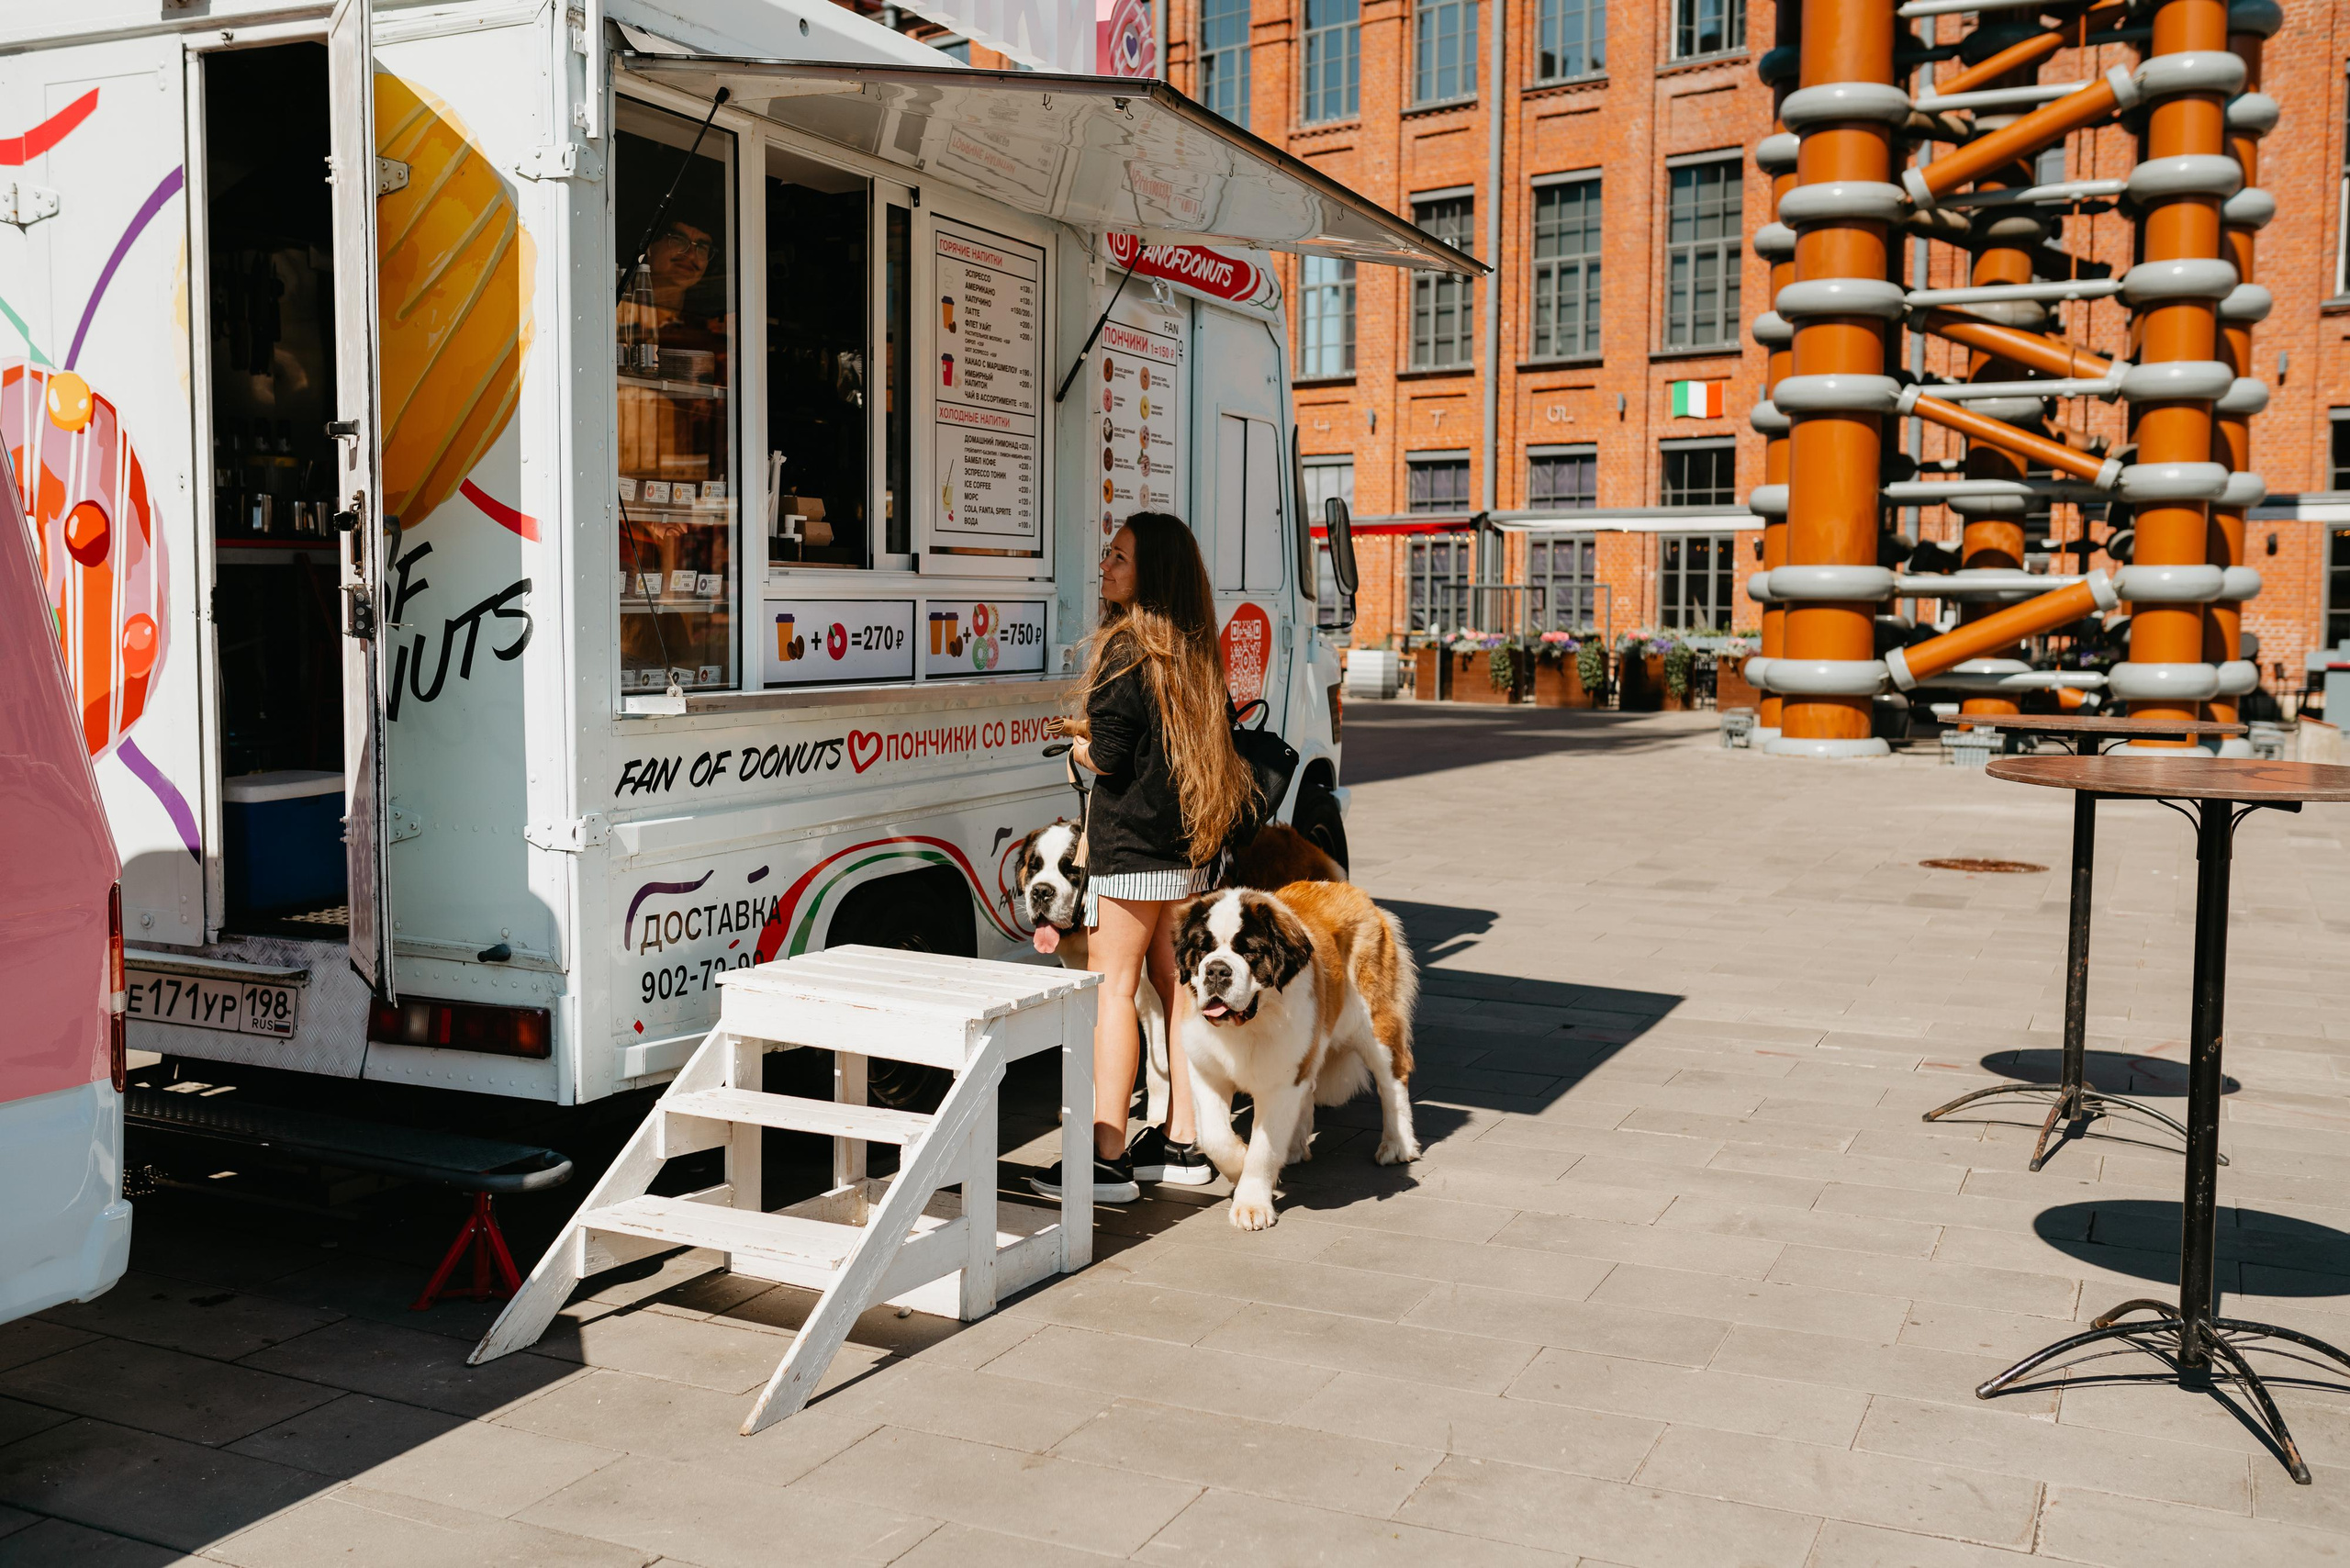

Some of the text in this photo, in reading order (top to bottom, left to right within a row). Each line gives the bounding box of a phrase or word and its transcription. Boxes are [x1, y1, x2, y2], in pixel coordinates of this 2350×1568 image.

[939, 239, 1002, 267] ГОРЯЧИЕ НАПИТКИ
[965, 268, 991, 283] ЭСПРЕССО
[965, 282, 996, 297] АМЕРИКАНО
[965, 294, 991, 308] КАПУЧИНО
[965, 306, 980, 318] ЛАТТЕ
[965, 319, 979, 329] ФЛЕТ
[979, 321, 991, 332] УАЙТ
[1164, 321, 1179, 335] FAN
[1104, 326, 1148, 353] ПОНЧИКИ
[965, 356, 981, 367] КАКАО
[965, 368, 993, 381] ИМБИРНЫЙ
[965, 378, 988, 389] НАПИТОК
[965, 389, 975, 399] ЧАЙ
[980, 393, 1017, 407] АССОРТИМЕНТЕ
[938, 407, 1010, 428] ХОЛОДНЫЕ НАПИТКИ
[965, 434, 993, 448] ДОМАШНИЙ
[994, 438, 1019, 451] ЛИМОНАД
[965, 455, 981, 465] БАМБЛ
[982, 457, 996, 466] КОФЕ
[965, 467, 990, 478] ЭСПРЕССО
[990, 470, 1007, 480] ТОНИК
[973, 480, 991, 490] COFFEE
[965, 492, 979, 501] МОРС
[965, 504, 979, 514] COLA,
[979, 506, 995, 516] FANTA,
[995, 507, 1012, 516] SPRITE
[965, 517, 979, 526] ВОДА
[886, 724, 977, 762] ПОНЧИКИ
[982, 721, 1005, 749] СО
[614, 737, 845, 799] FAN OF DONUTS
[640, 894, 782, 956] ДОСТАВКА
[245, 987, 289, 1019] 198
[252, 1018, 274, 1031] RUS
